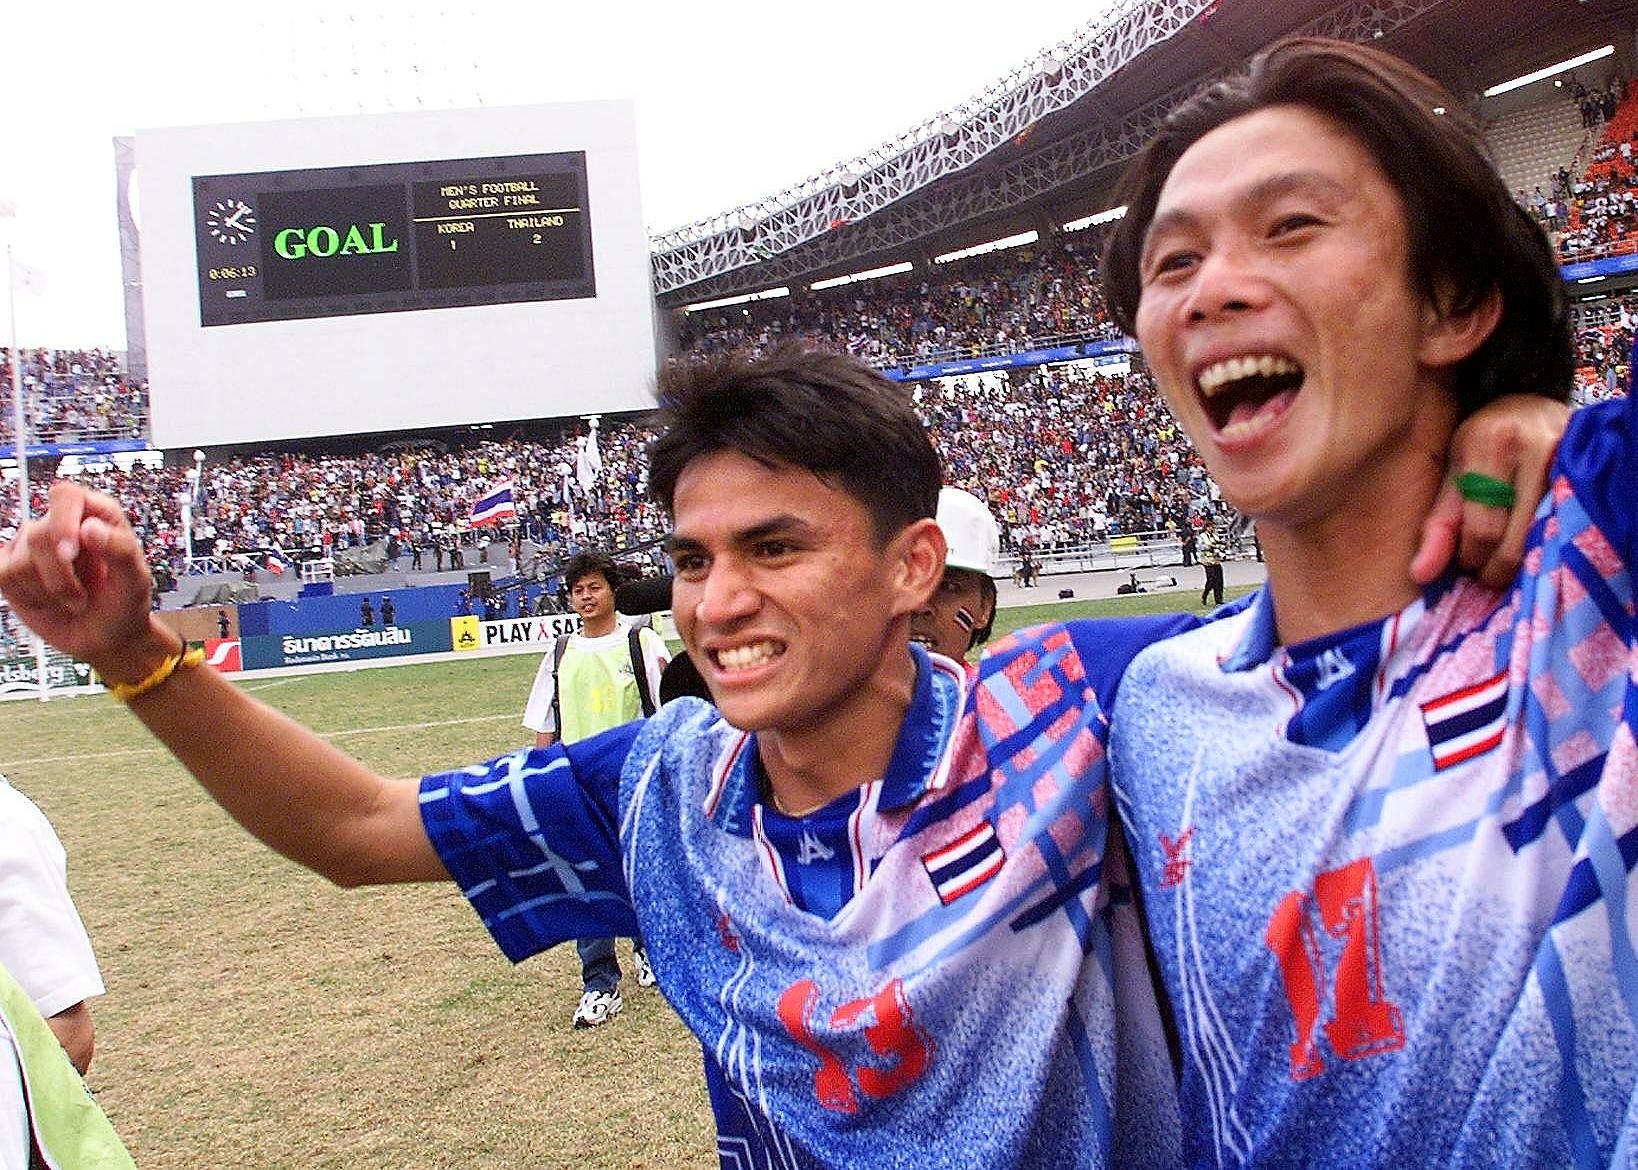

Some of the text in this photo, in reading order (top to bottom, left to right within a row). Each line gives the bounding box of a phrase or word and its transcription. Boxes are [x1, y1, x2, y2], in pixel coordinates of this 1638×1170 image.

[440, 181, 540, 197] MEN'S FOOTBALL
[448, 194, 540, 210] QUARTER FINAL
[437, 215, 564, 235] KOREA THAILAND
[274, 222, 399, 260] GOAL
[450, 233, 543, 251] 1 2
[486, 622, 532, 645] PLAY
[775, 977, 938, 1114] 13
